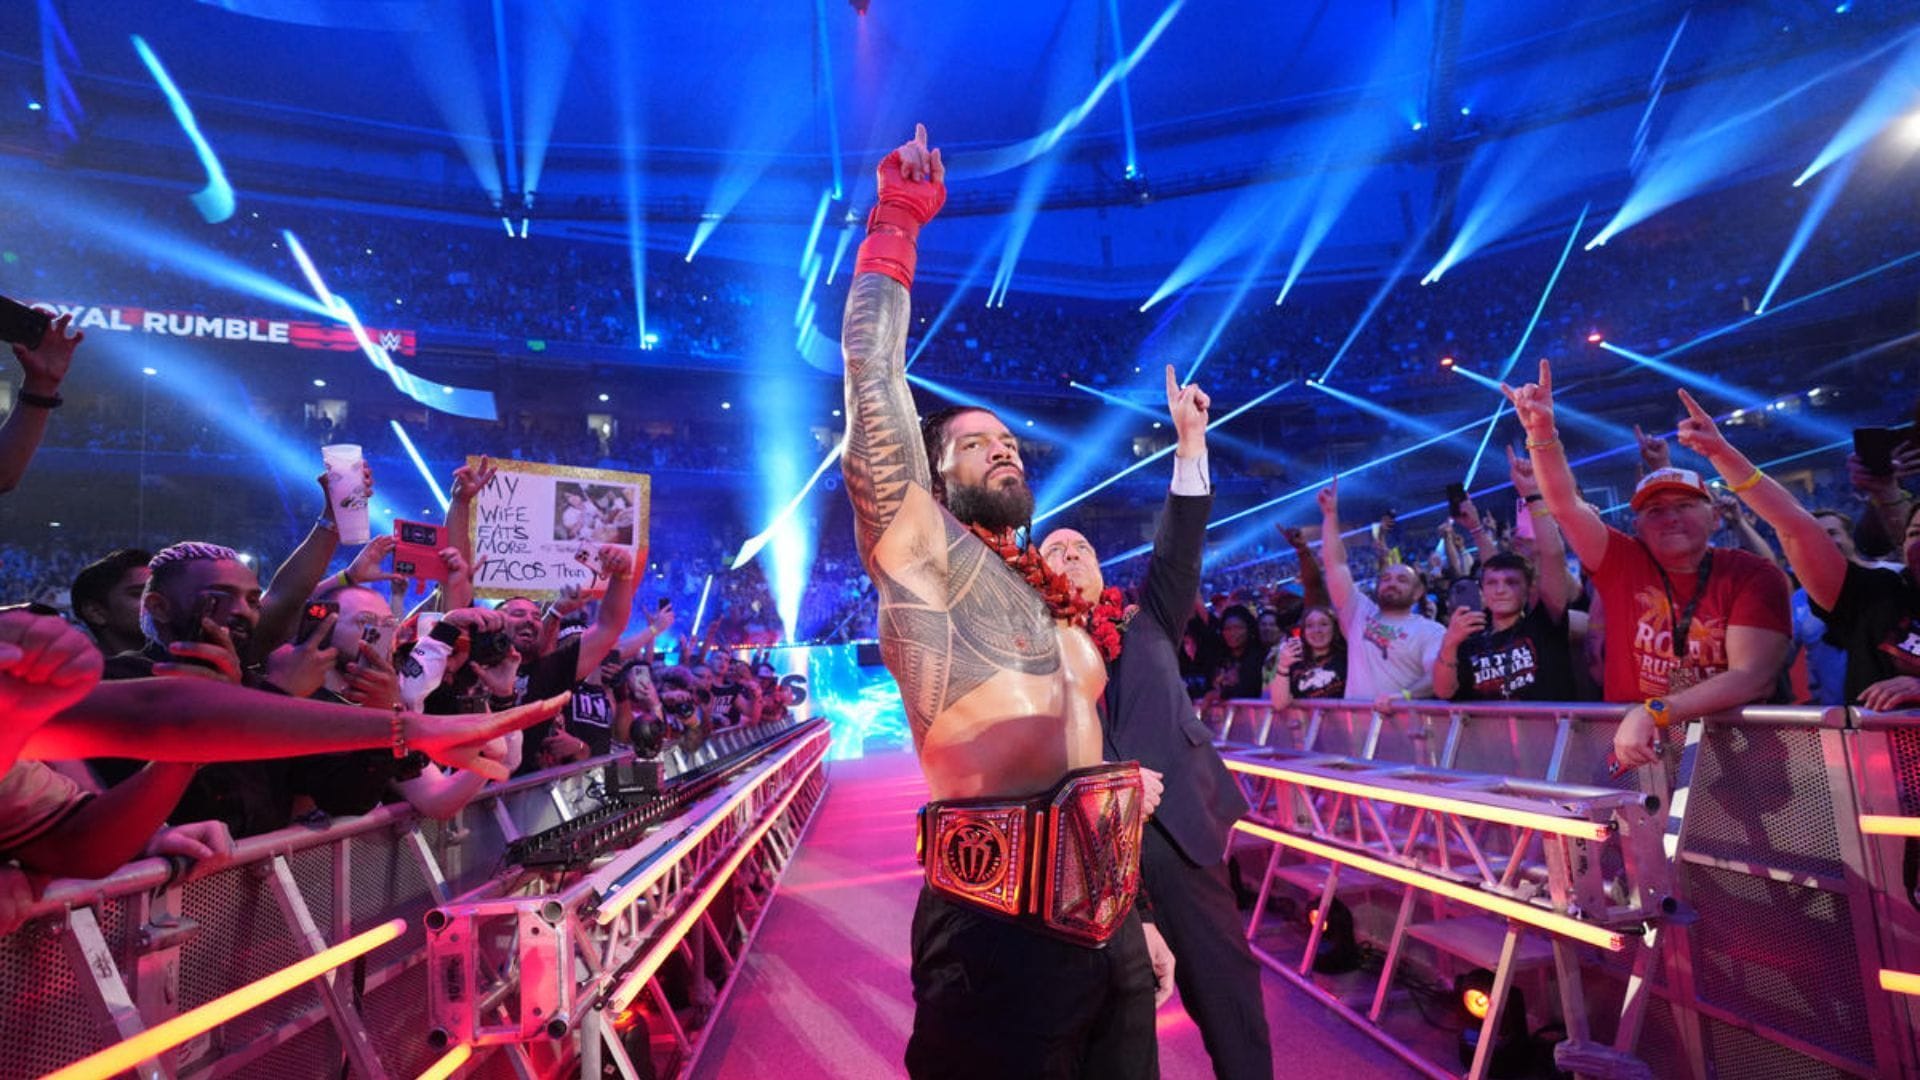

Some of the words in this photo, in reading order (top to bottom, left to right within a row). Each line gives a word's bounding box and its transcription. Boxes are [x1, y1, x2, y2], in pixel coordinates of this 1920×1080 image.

[16, 301, 132, 331] YAL
[143, 312, 290, 344] RUMBLE
[482, 474, 519, 506] MY
[480, 558, 547, 583] TACOS
[551, 562, 587, 580] Than
